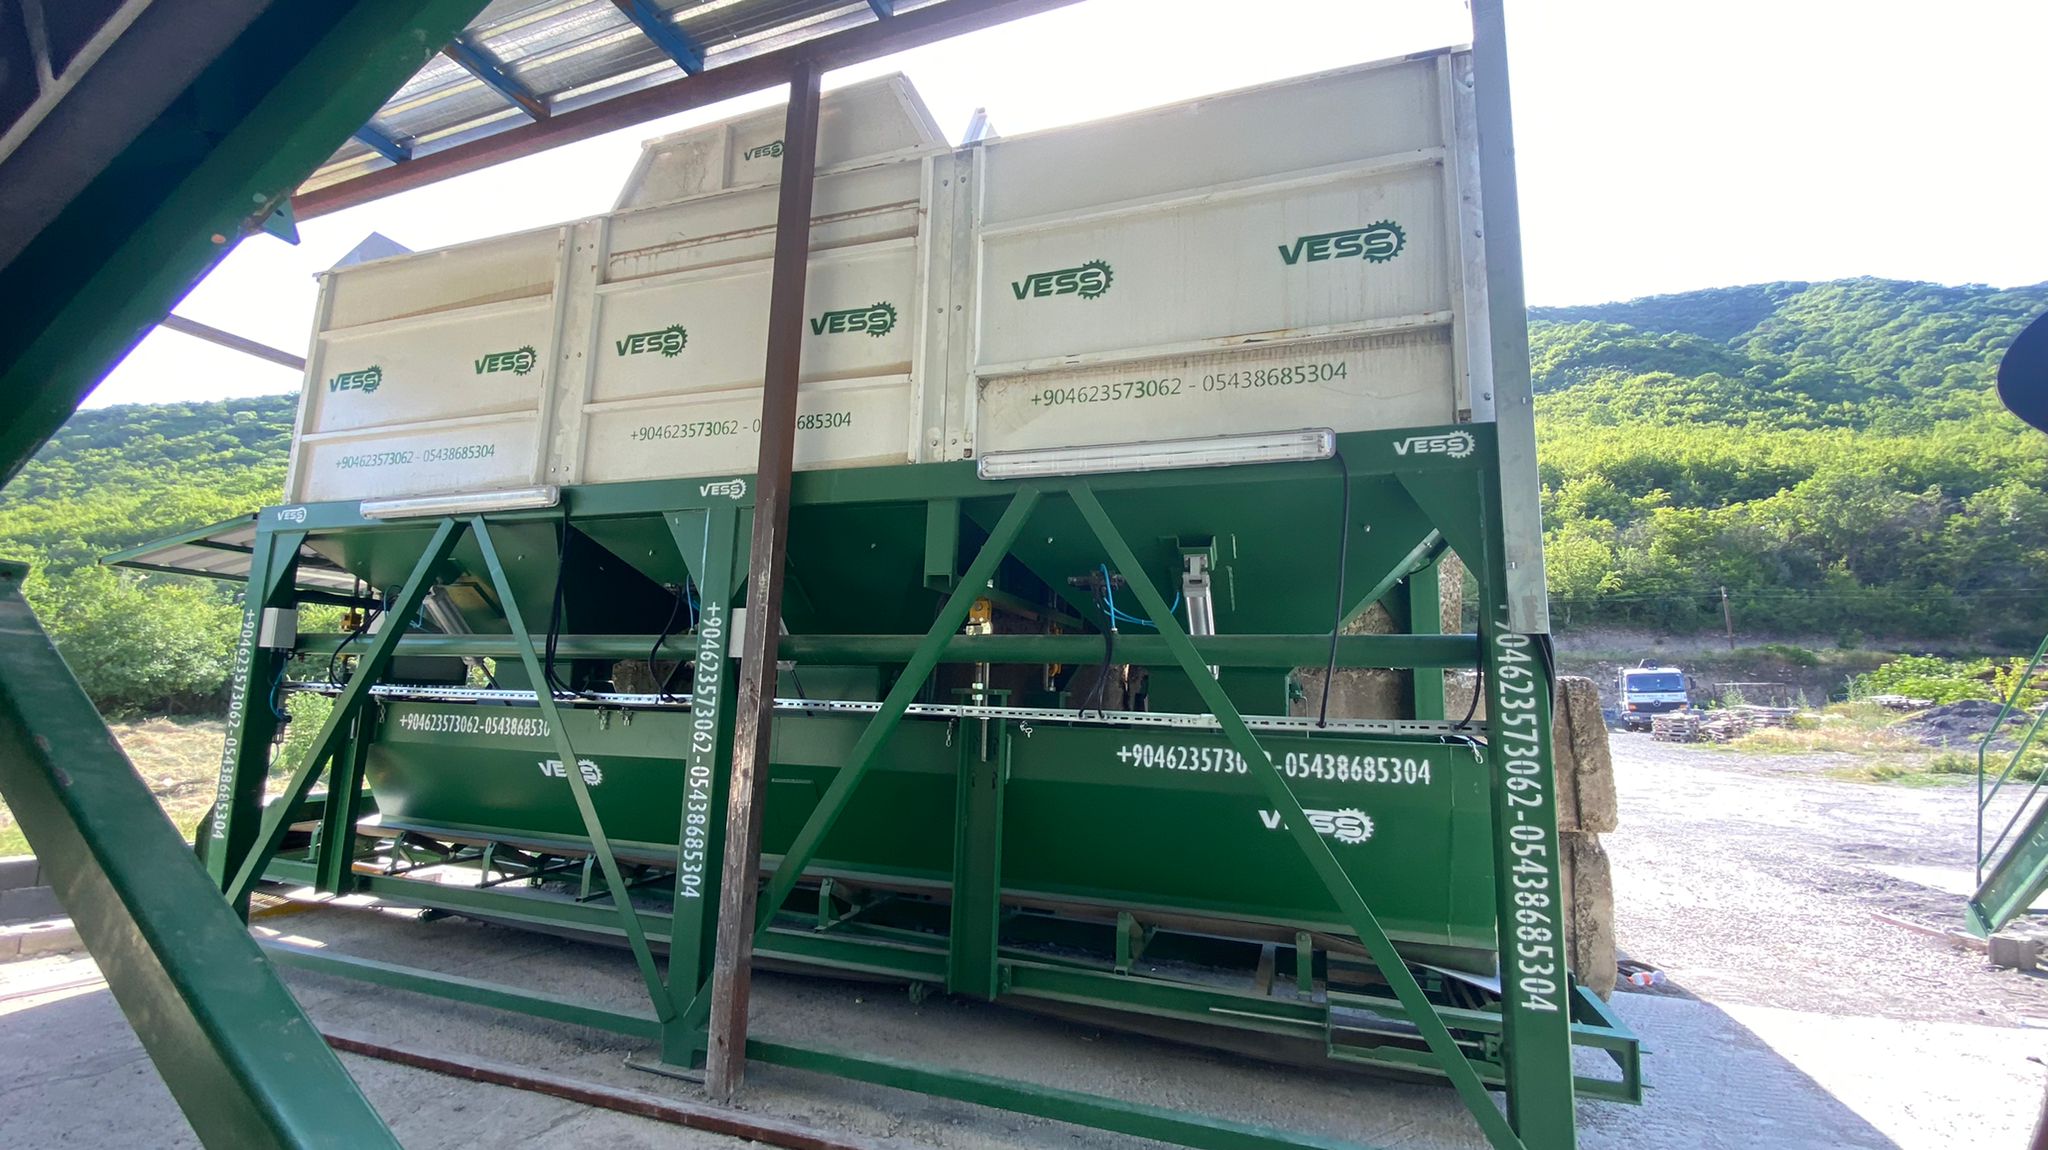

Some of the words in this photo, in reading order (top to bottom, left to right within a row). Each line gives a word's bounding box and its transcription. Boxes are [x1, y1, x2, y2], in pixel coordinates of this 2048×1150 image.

[744, 140, 784, 161] VESS
[1278, 219, 1406, 268] VESS
[1012, 259, 1114, 300] VESS
[810, 301, 897, 338] VESS
[615, 324, 688, 358] VESS
[474, 345, 537, 376] VESS
[329, 365, 382, 394] VESS
[1031, 377, 1182, 408] +904623573062
[1202, 361, 1347, 393] 05438685304
[631, 420, 738, 441] +904623573062
[1392, 430, 1475, 459] VESS
[336, 451, 414, 469] +904623573062
[423, 444, 495, 462] 05438685304
[699, 478, 746, 500] VESS
[277, 507, 307, 523] VESS
[211, 609, 255, 840] +904623573062-05438685304
[680, 601, 722, 899] +904623573062-05438685304
[1116, 744, 1431, 785] +9046235730-05438685304
[538, 759, 603, 786] VES
[1258, 807, 1374, 844] VSS
[1495, 604, 1558, 1013] 04623573062-05438685304
